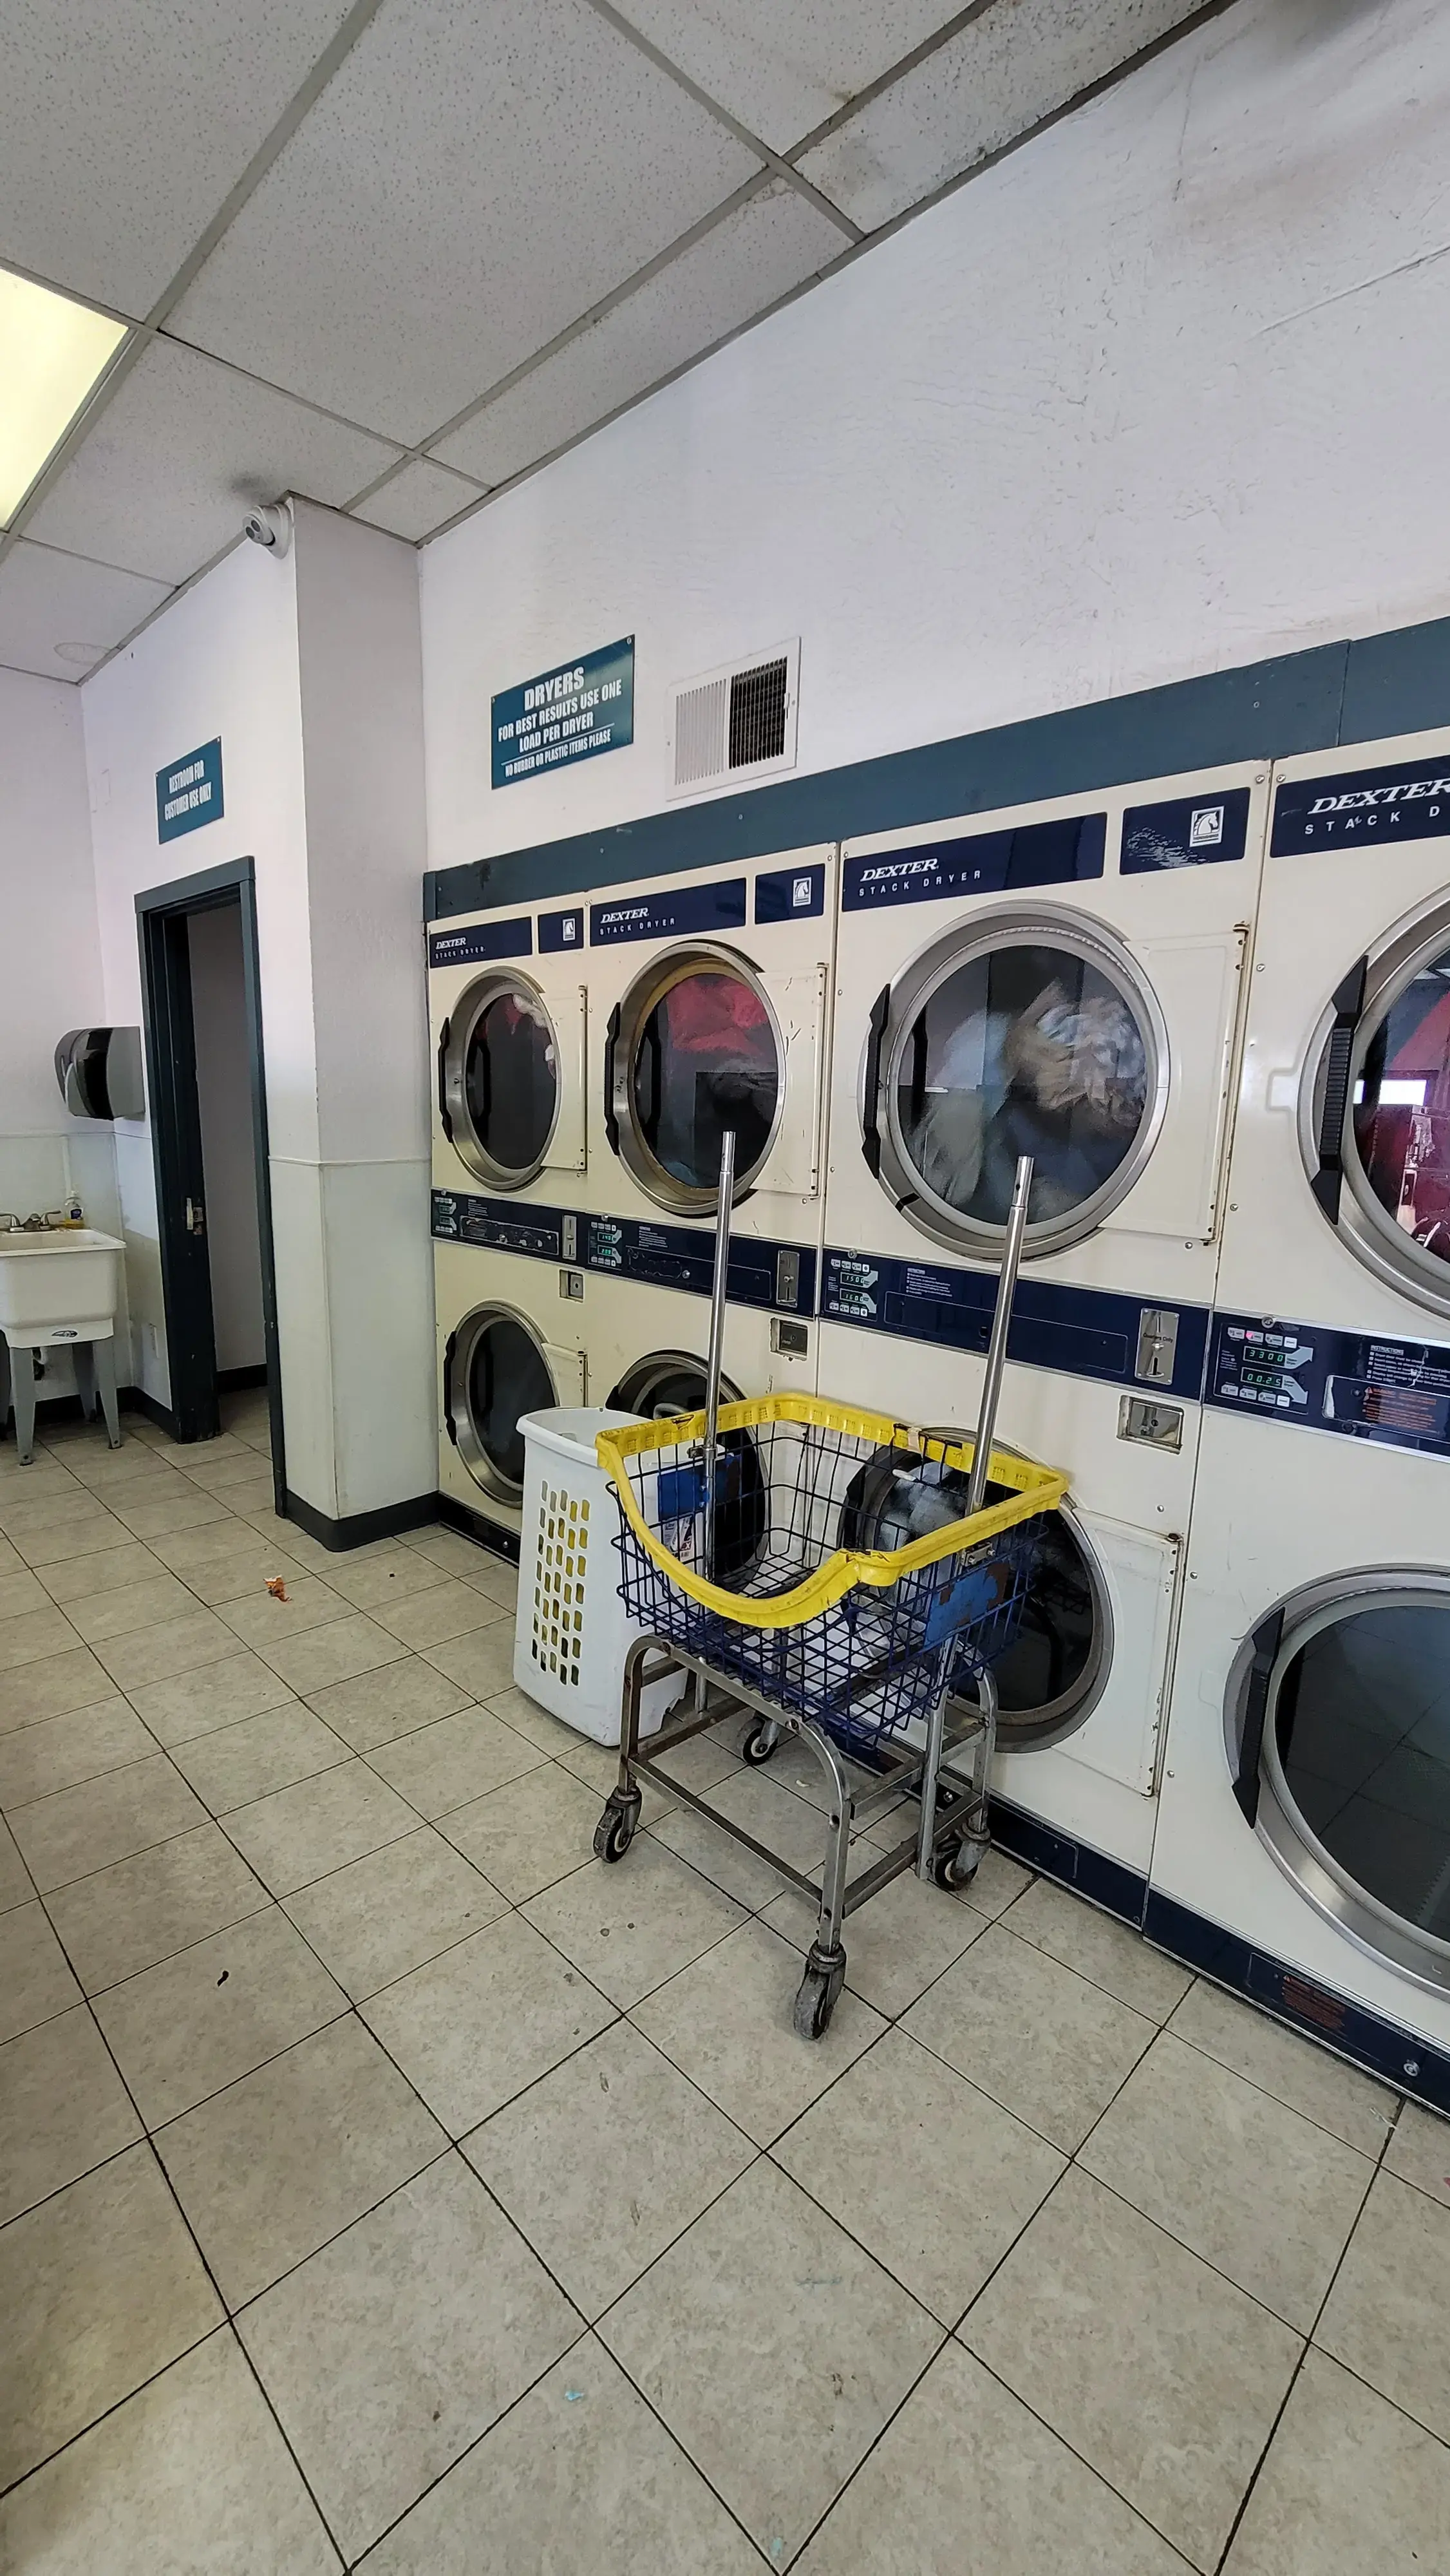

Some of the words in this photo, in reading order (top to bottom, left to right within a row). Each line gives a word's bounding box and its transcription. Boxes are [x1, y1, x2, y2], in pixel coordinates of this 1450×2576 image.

[524, 667, 584, 711] DRYERS
[498, 723, 514, 742] FOR
[516, 713, 537, 735] BEST
[539, 697, 578, 726] RESULTS
[580, 688, 599, 709] USE
[601, 679, 622, 701] ONE
[519, 731, 541, 753] LOAD
[543, 724, 560, 744] PER
[562, 711, 594, 737] DRYER
[505, 762, 513, 777] NO
[514, 756, 535, 775] RUBBER
[536, 753, 543, 766] OR
[545, 745, 569, 763] PLASTIC
[569, 739, 588, 755] ITEMS
[588, 728, 611, 748] PLEASE
[169, 765, 194, 793] RESTROOM
[194, 760, 204, 781] FOR
[164, 793, 189, 820] CUSTOMER
[189, 788, 199, 809] USE
[199, 781, 212, 804] ONLY
[1307, 777, 1450, 815] DEXTER
[1304, 811, 1402, 835] STACK
[859, 881, 910, 896] STACK
[923, 870, 981, 887] DRYER
[860, 858, 938, 882] DEXTER
[599, 924, 632, 935] STACK
[639, 918, 675, 929] DRYER
[600, 907, 649, 923] DEXTER
[435, 937, 466, 949] DEXTER
